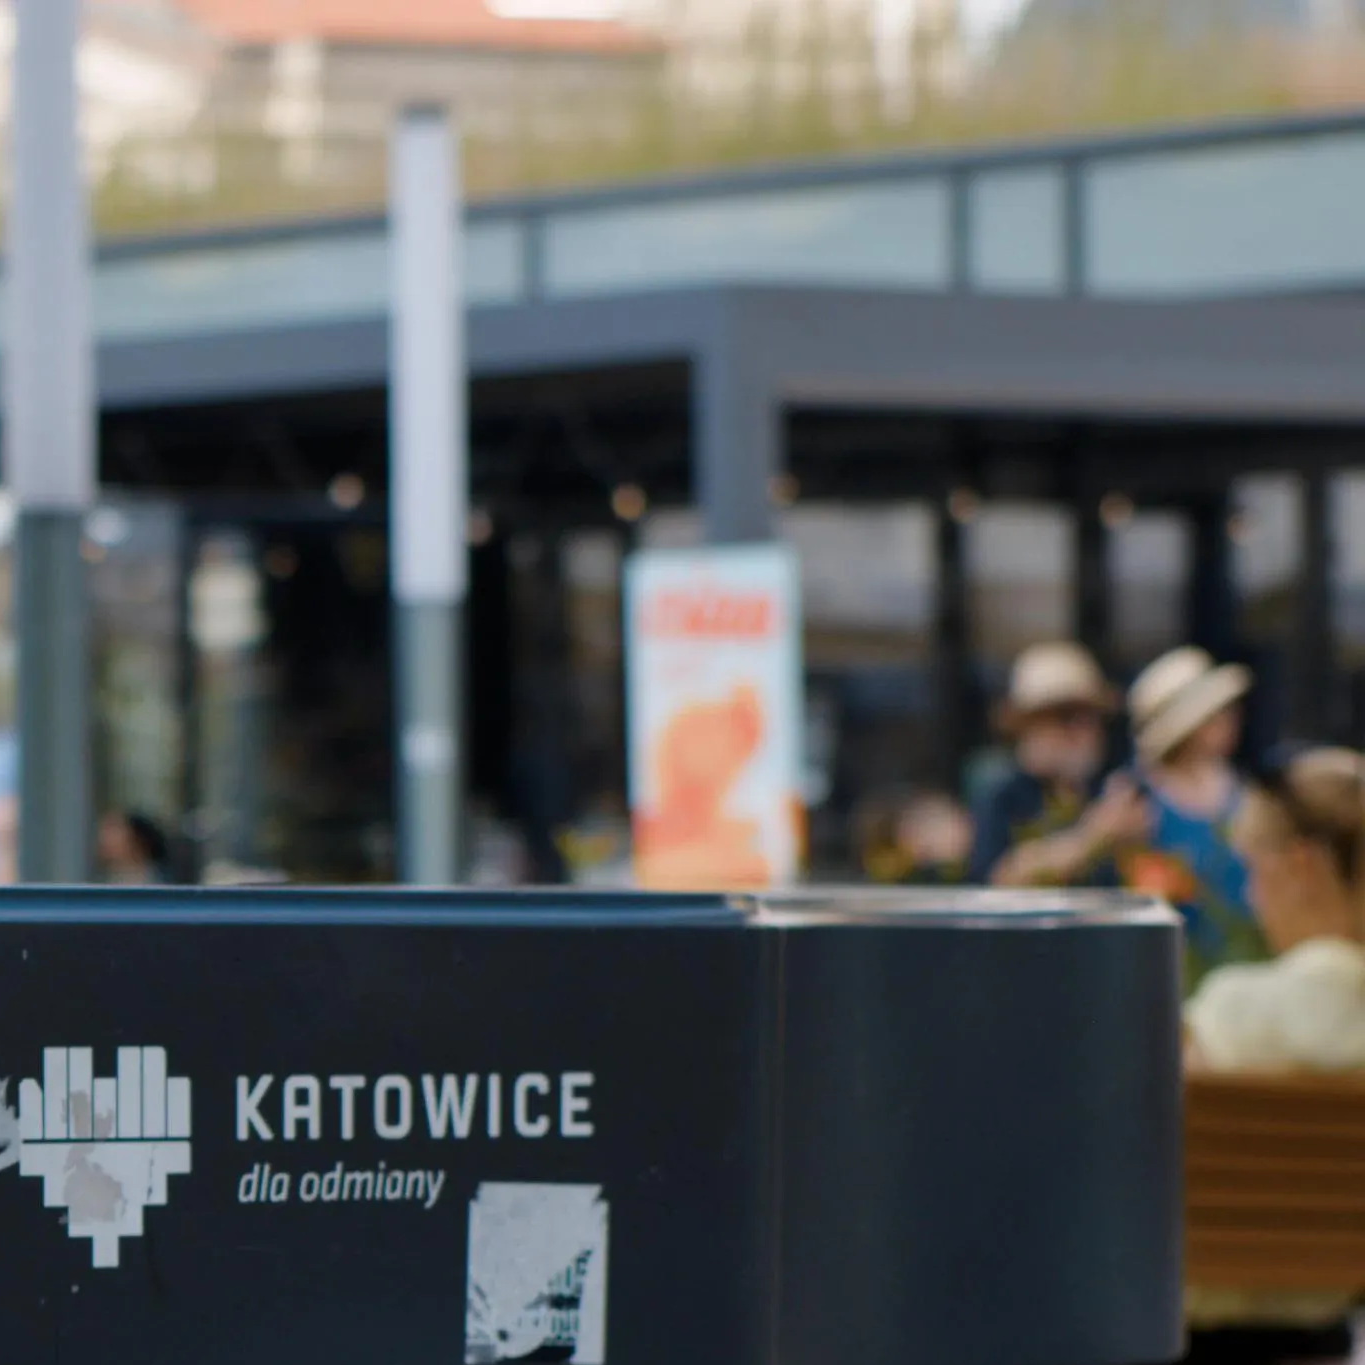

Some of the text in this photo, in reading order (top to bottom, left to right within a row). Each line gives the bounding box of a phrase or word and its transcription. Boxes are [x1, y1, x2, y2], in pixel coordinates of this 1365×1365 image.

[235, 1071, 595, 1142] KATOWICE
[237, 1160, 446, 1209] dla odmiany
